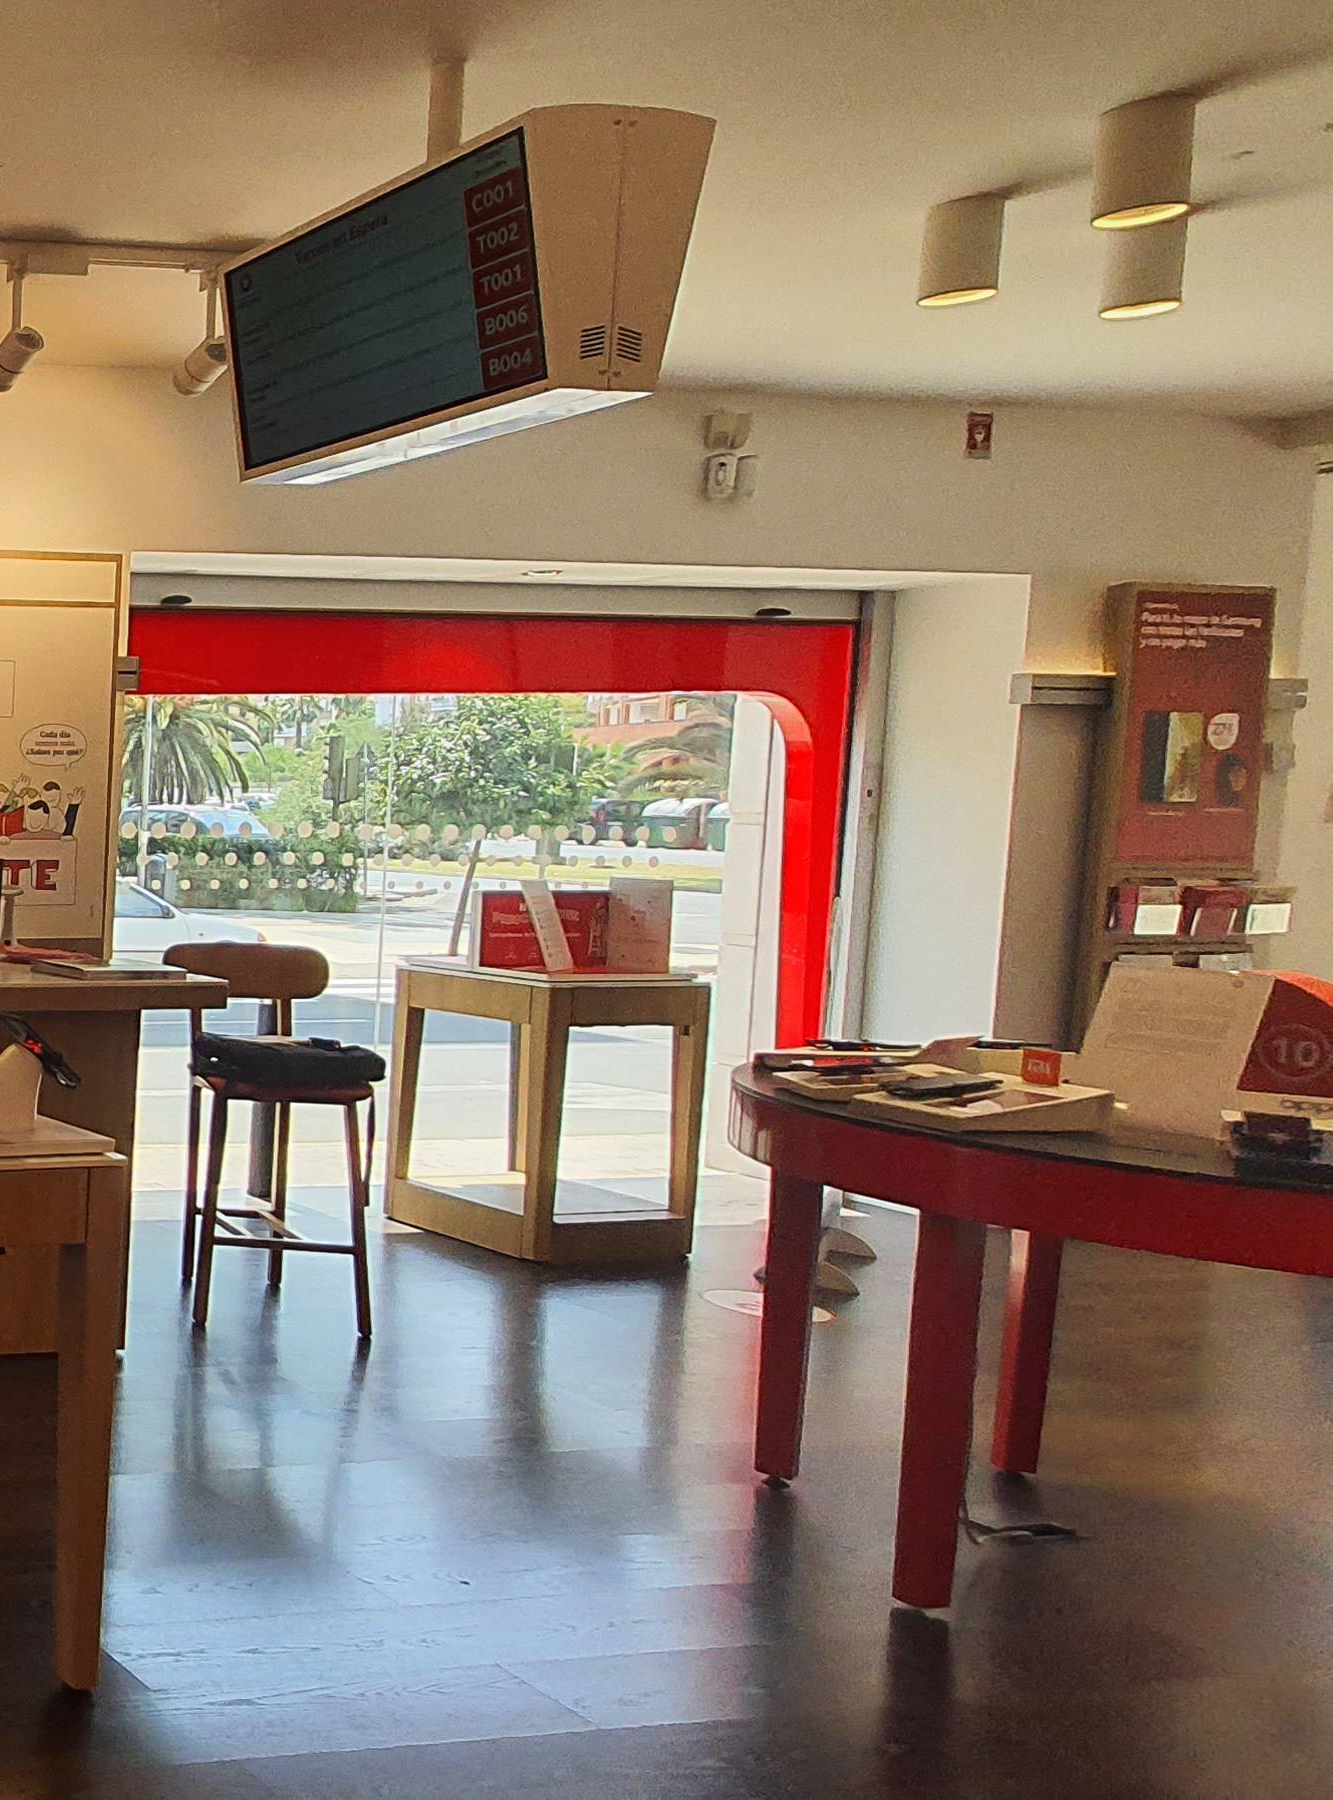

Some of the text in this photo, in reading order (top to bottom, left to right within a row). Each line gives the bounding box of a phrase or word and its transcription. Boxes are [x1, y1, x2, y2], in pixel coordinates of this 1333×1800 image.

[472, 180, 513, 213] C001
[476, 222, 518, 254] T002
[480, 263, 522, 296] T001
[484, 304, 528, 335] B006
[489, 348, 532, 376] B004
[1272, 1038, 1322, 1069] 10
